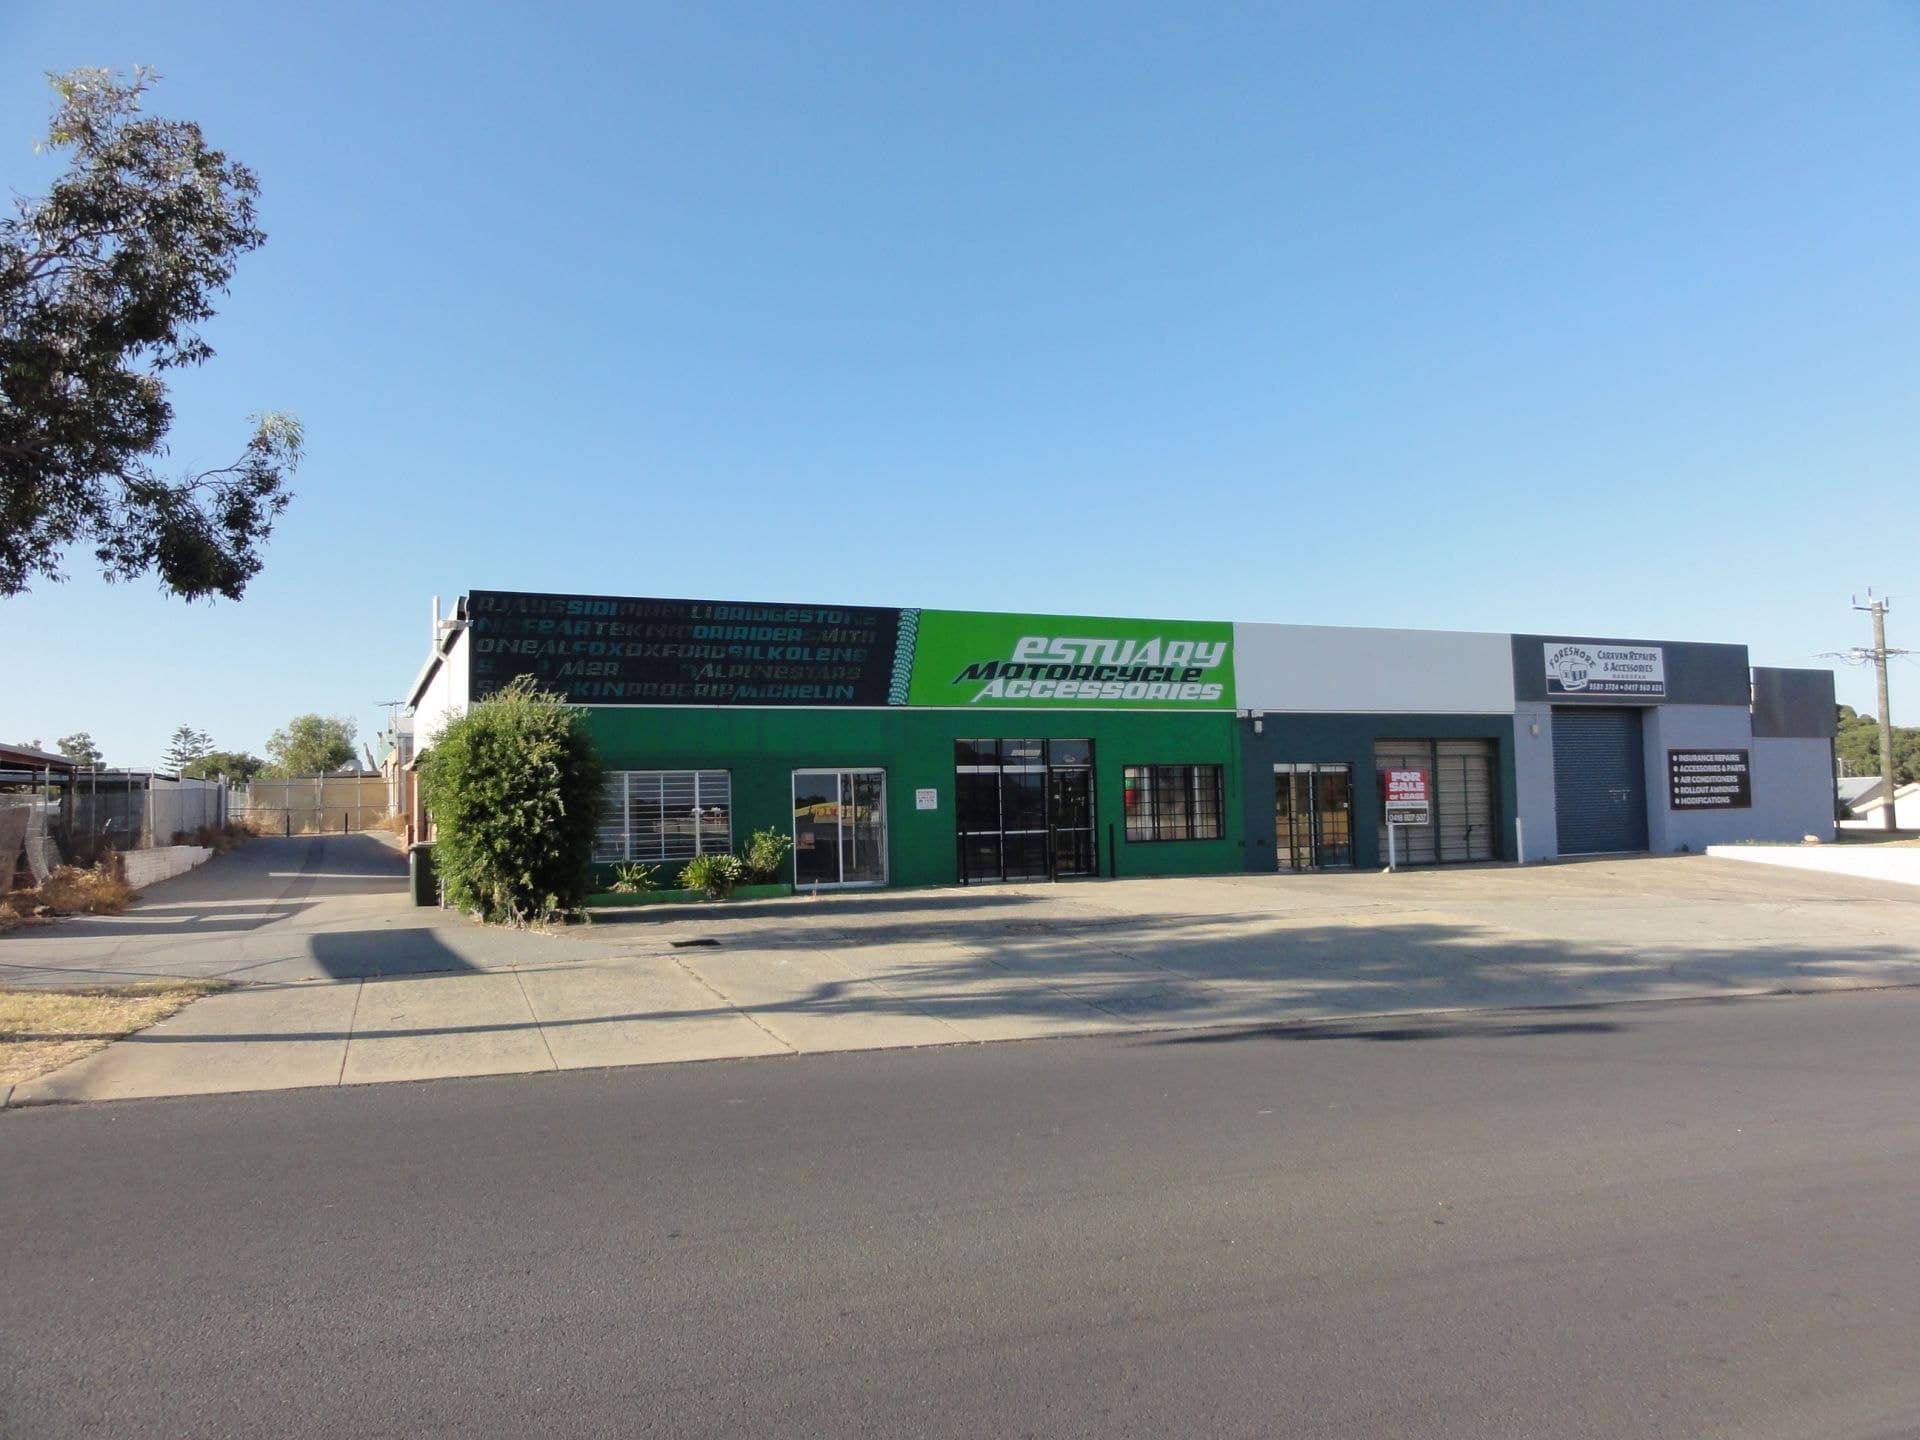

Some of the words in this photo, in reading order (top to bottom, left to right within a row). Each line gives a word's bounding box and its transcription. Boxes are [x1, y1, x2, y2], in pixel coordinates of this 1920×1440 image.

[567, 600, 618, 616] SIDI
[1549, 646, 1596, 669] FORESHORE
[1597, 650, 1628, 661] CARAVAN
[1629, 651, 1657, 662] REPAIRS
[952, 660, 1202, 684] MOTORCYCLE
[1603, 662, 1609, 672] &
[1610, 662, 1654, 673] ACCESSORIES
[731, 684, 856, 701] MICHELIN
[1727, 764, 1746, 772] PARTS
[1391, 772, 1421, 781] FOR
[1389, 782, 1424, 791] SALE
